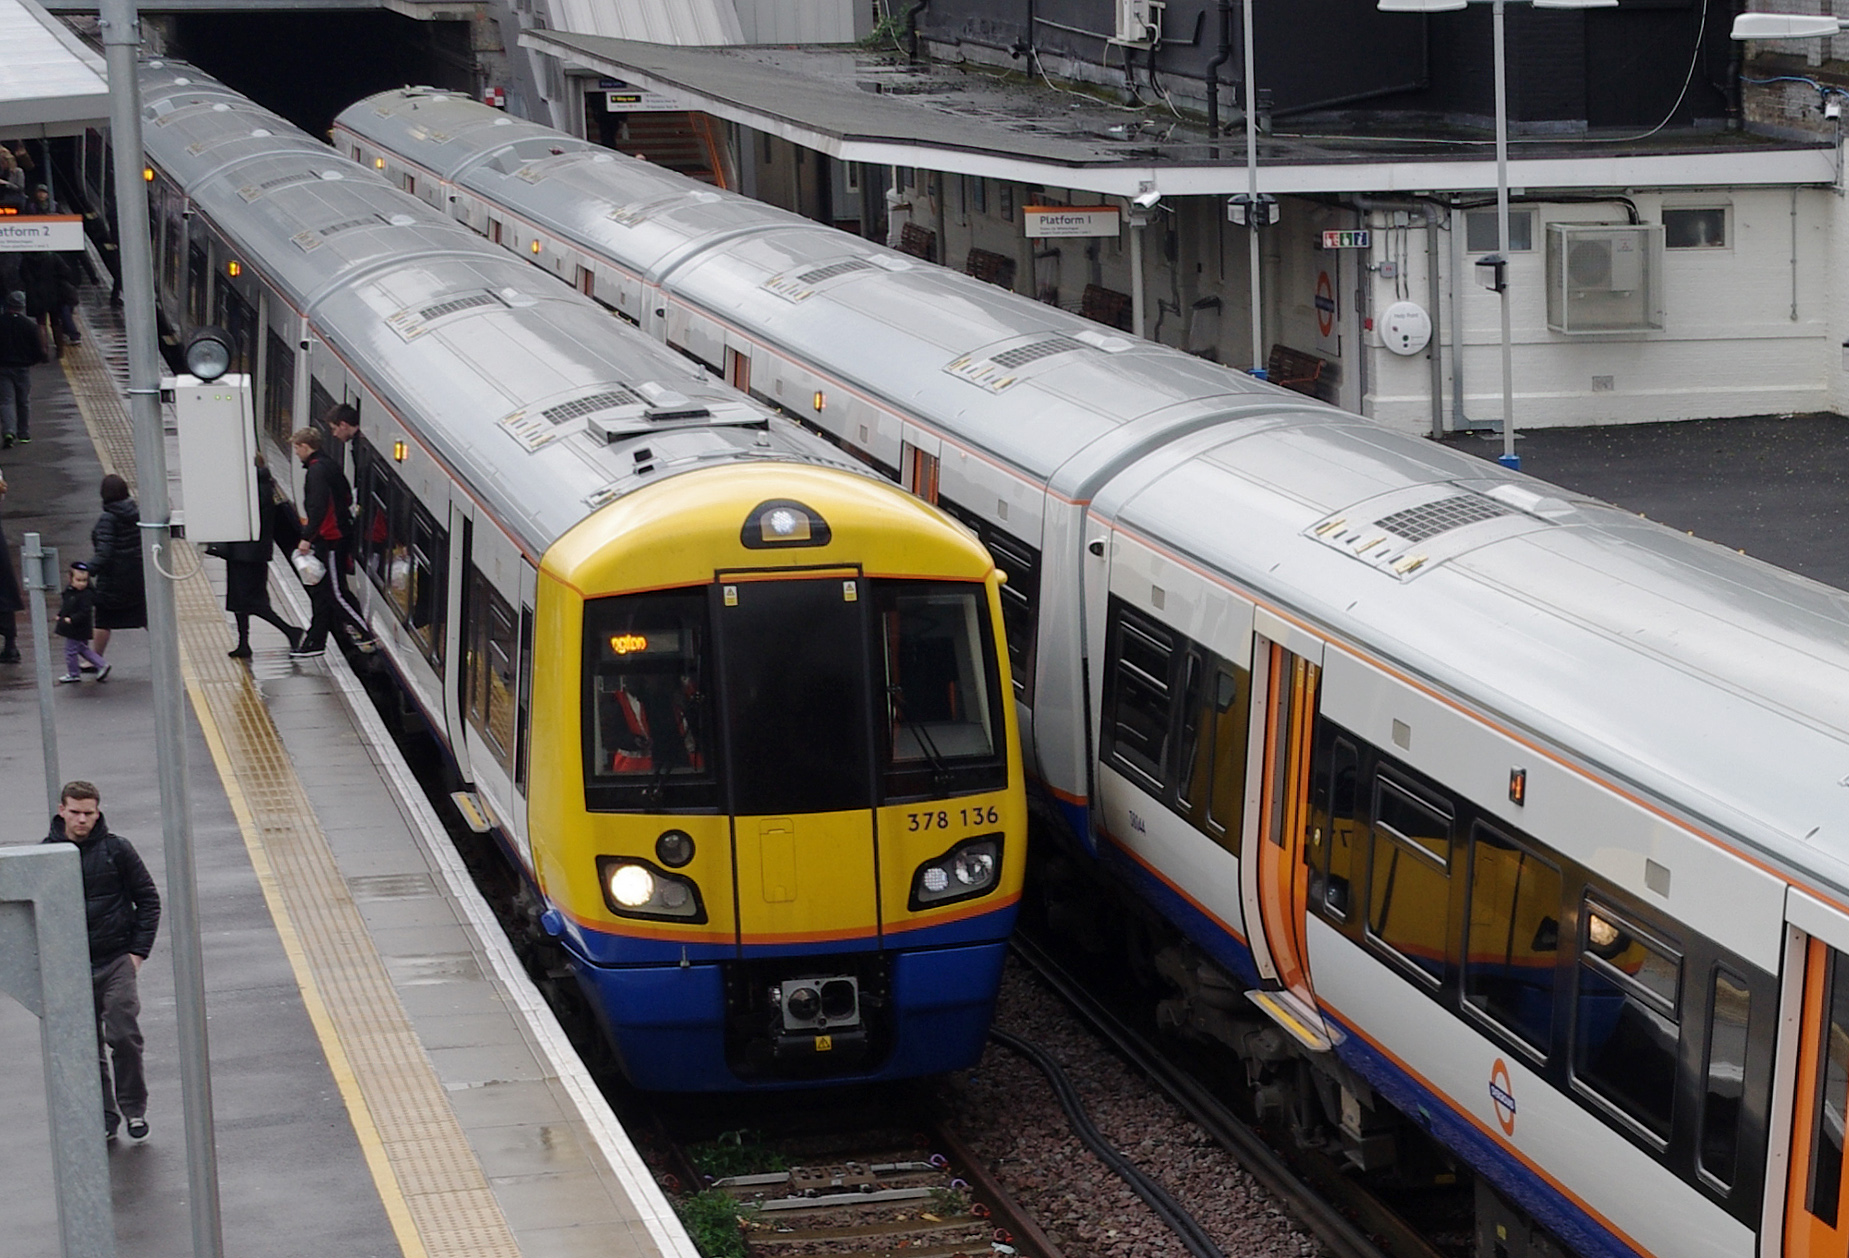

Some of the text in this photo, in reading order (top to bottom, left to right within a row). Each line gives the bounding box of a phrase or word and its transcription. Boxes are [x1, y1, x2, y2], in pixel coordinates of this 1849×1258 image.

[1040, 215, 1084, 224] Platform
[43, 226, 50, 236] 2
[907, 805, 998, 832] 378 136
